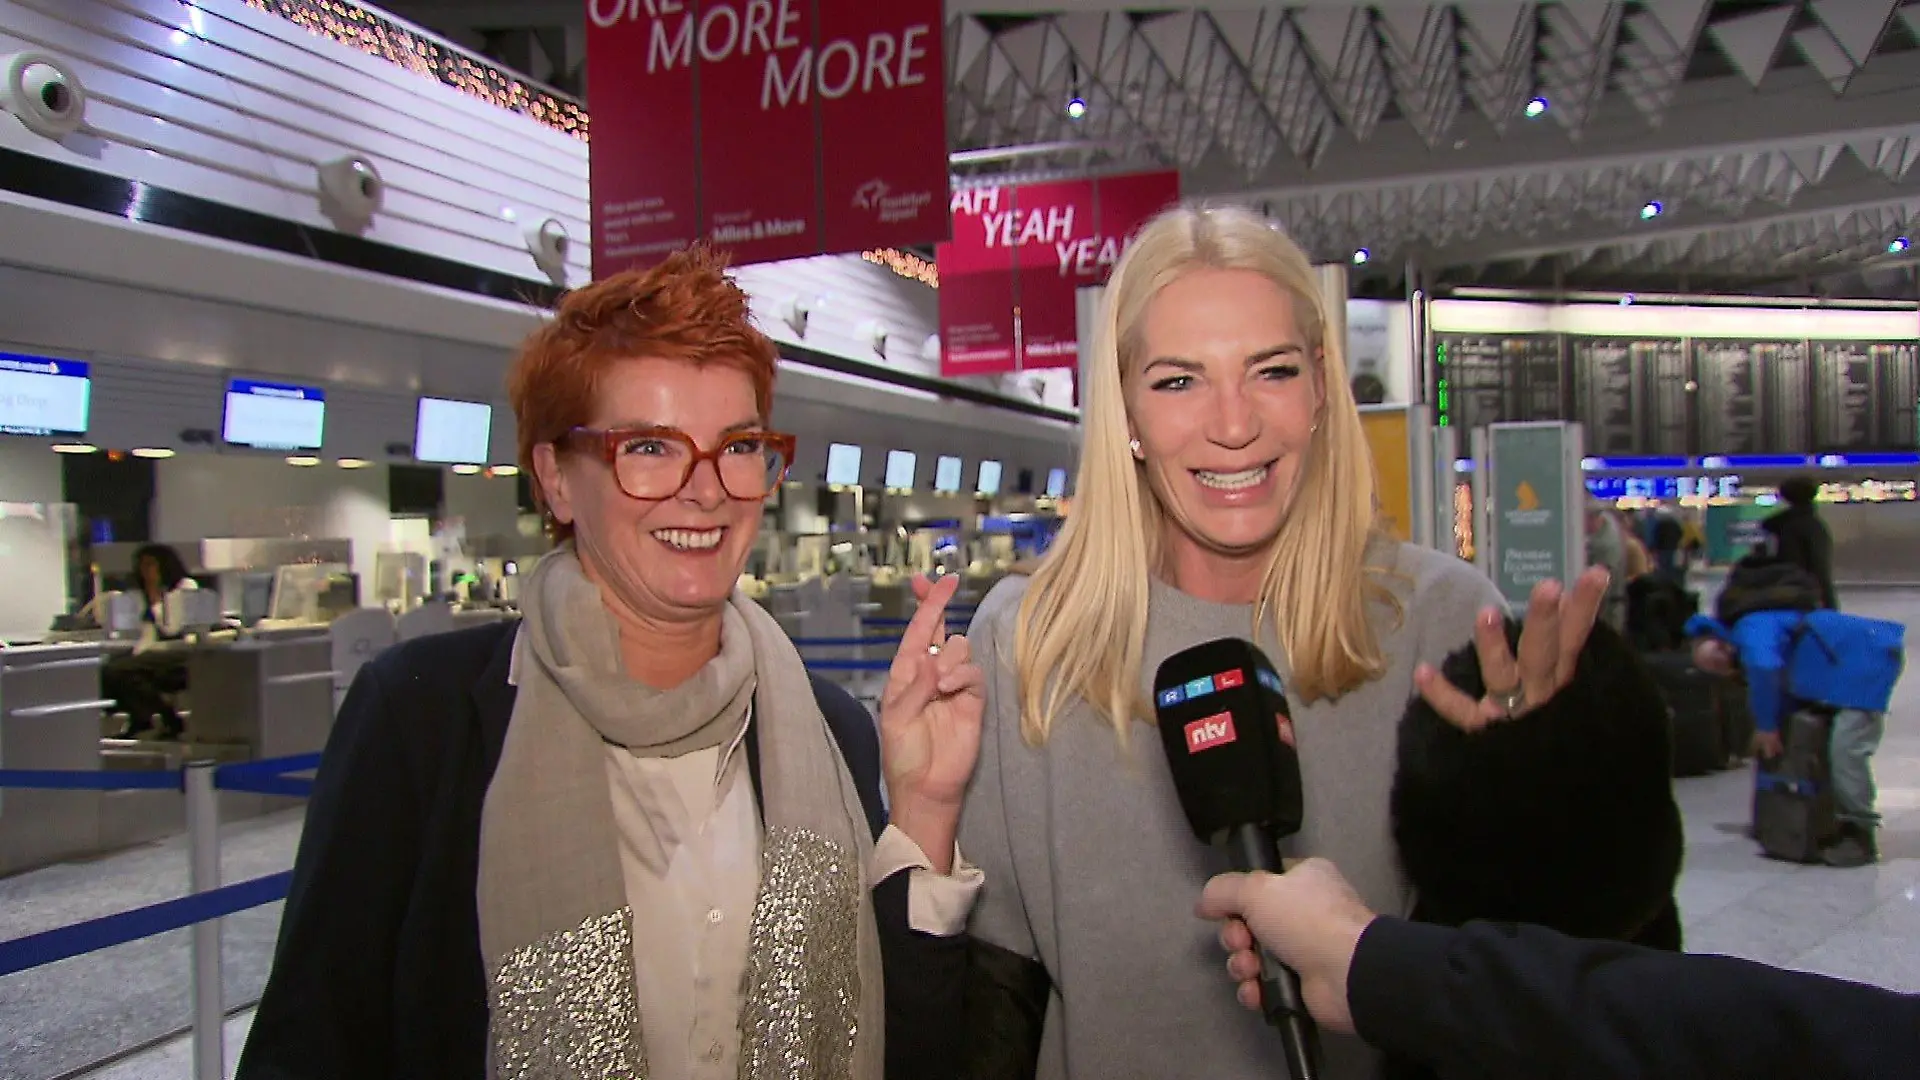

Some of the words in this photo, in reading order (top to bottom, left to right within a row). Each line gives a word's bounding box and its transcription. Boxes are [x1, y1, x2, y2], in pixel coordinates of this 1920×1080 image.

[646, 0, 800, 74] MORE
[760, 24, 930, 111] MORE
[981, 203, 1076, 249] YEAH
[1165, 676, 1236, 703] RTL
[1191, 721, 1228, 746] ntv
